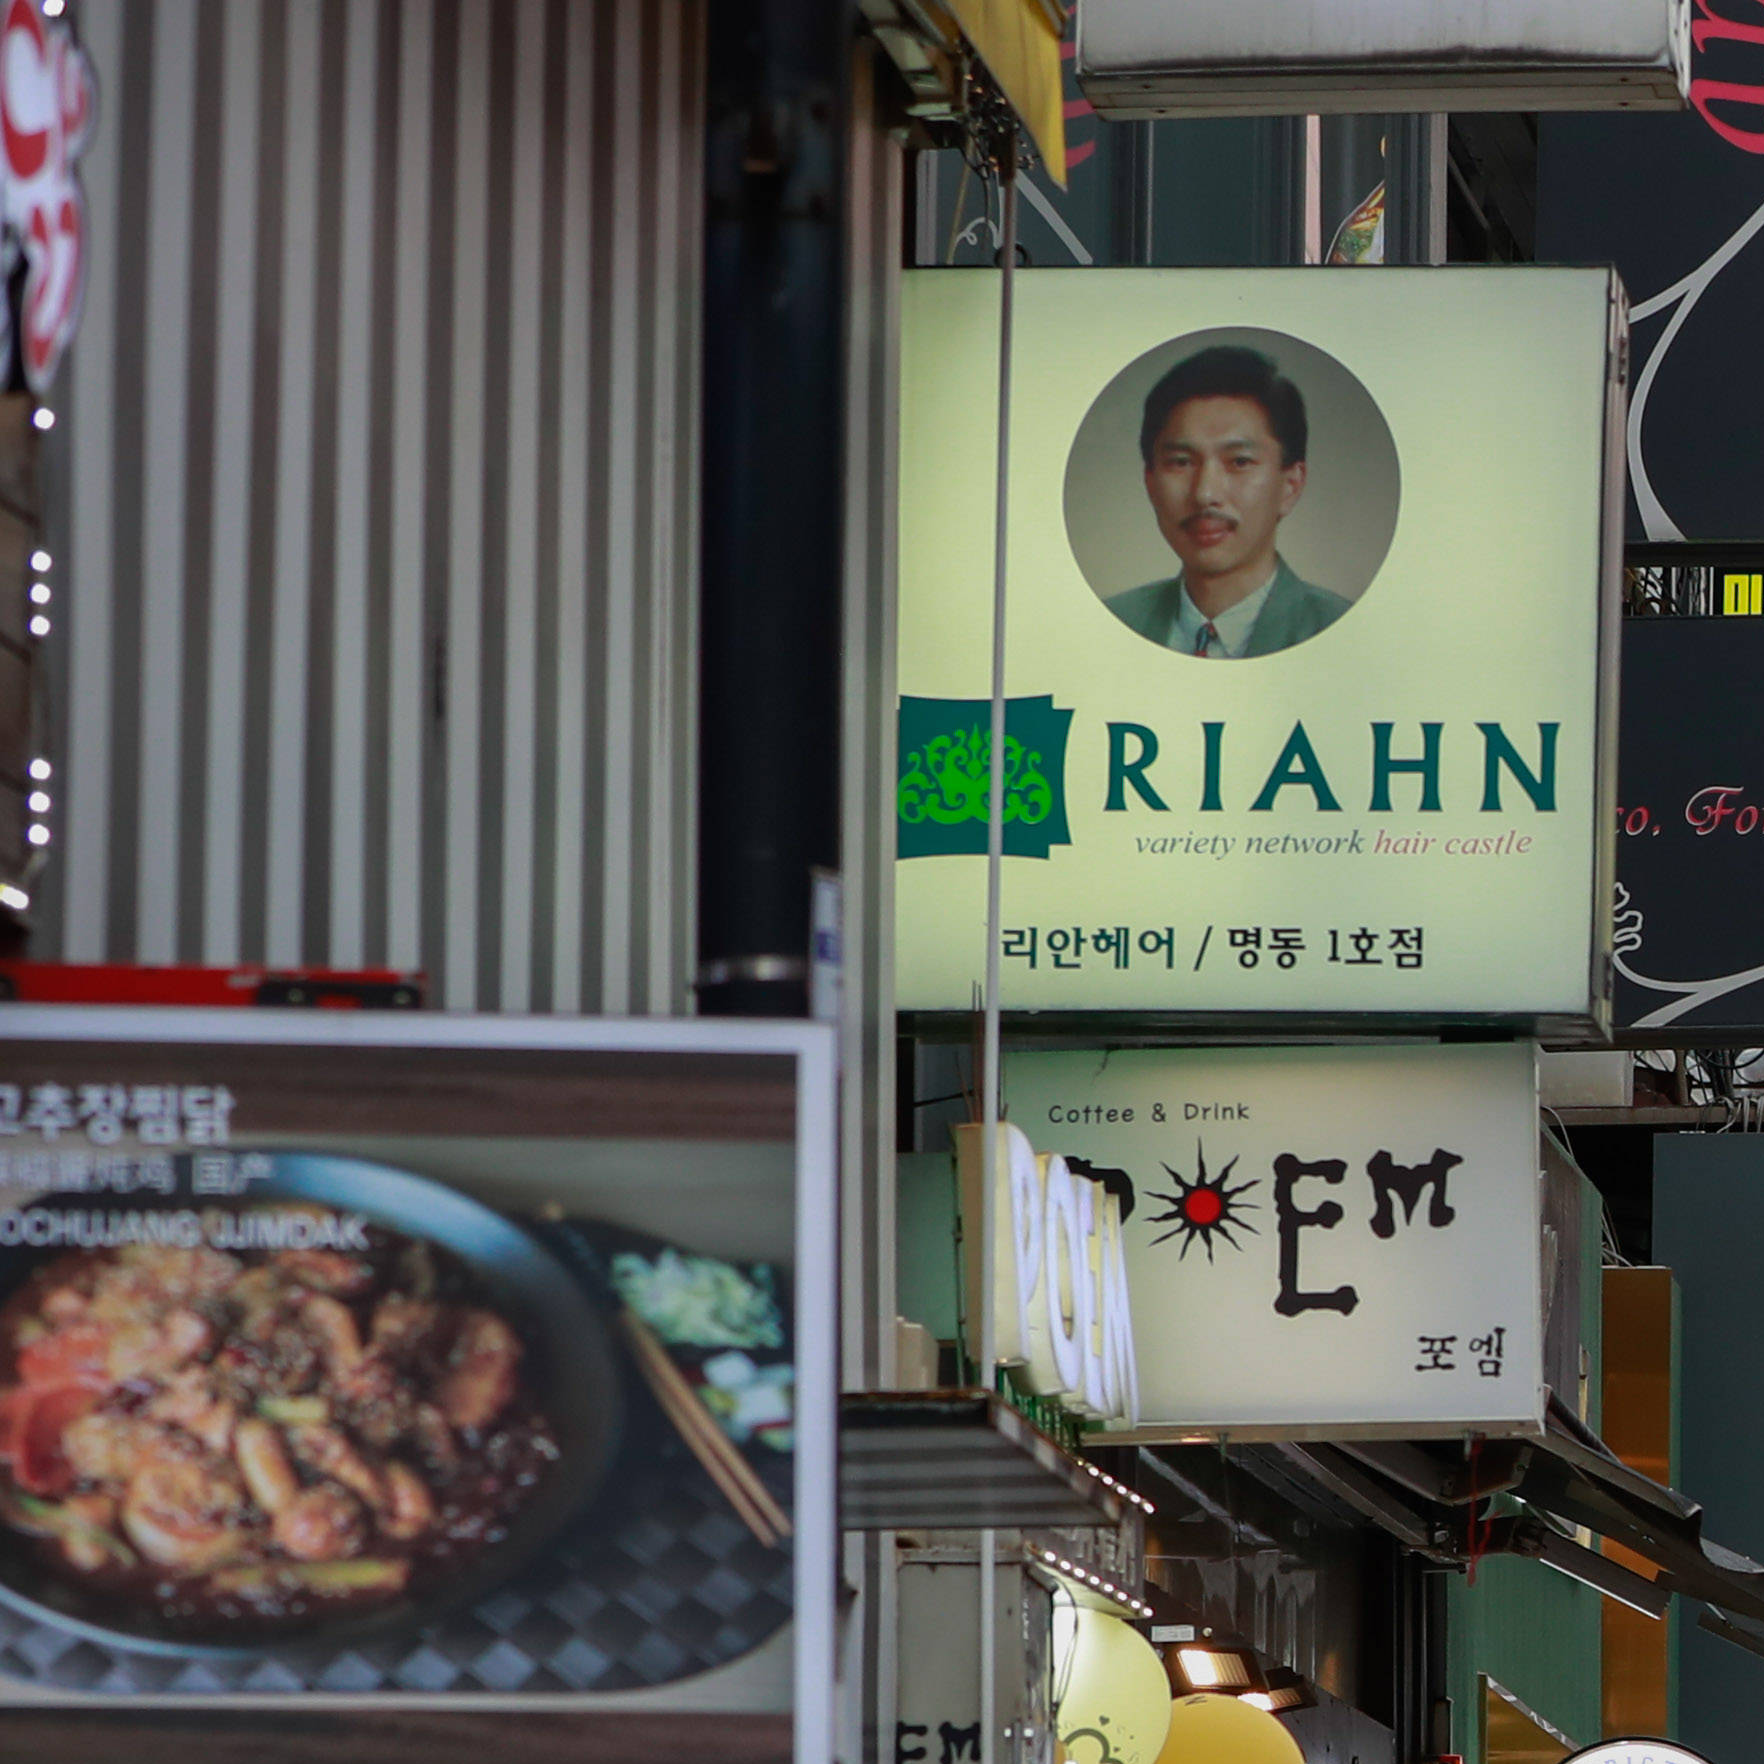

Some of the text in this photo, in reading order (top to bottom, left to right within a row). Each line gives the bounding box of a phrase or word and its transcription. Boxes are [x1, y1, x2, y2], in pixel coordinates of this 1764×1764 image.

[1103, 718, 1561, 813] RIAHN
[1135, 829, 1534, 858] variety network hair castle
[1001, 926, 1176, 971] 리안헤어
[1228, 926, 1307, 971] 명동
[1328, 926, 1426, 971] 1호점
[1048, 1102, 1135, 1125] Coffee
[1184, 1101, 1251, 1122] Drink
[1415, 1326, 1507, 1378] 포엠
